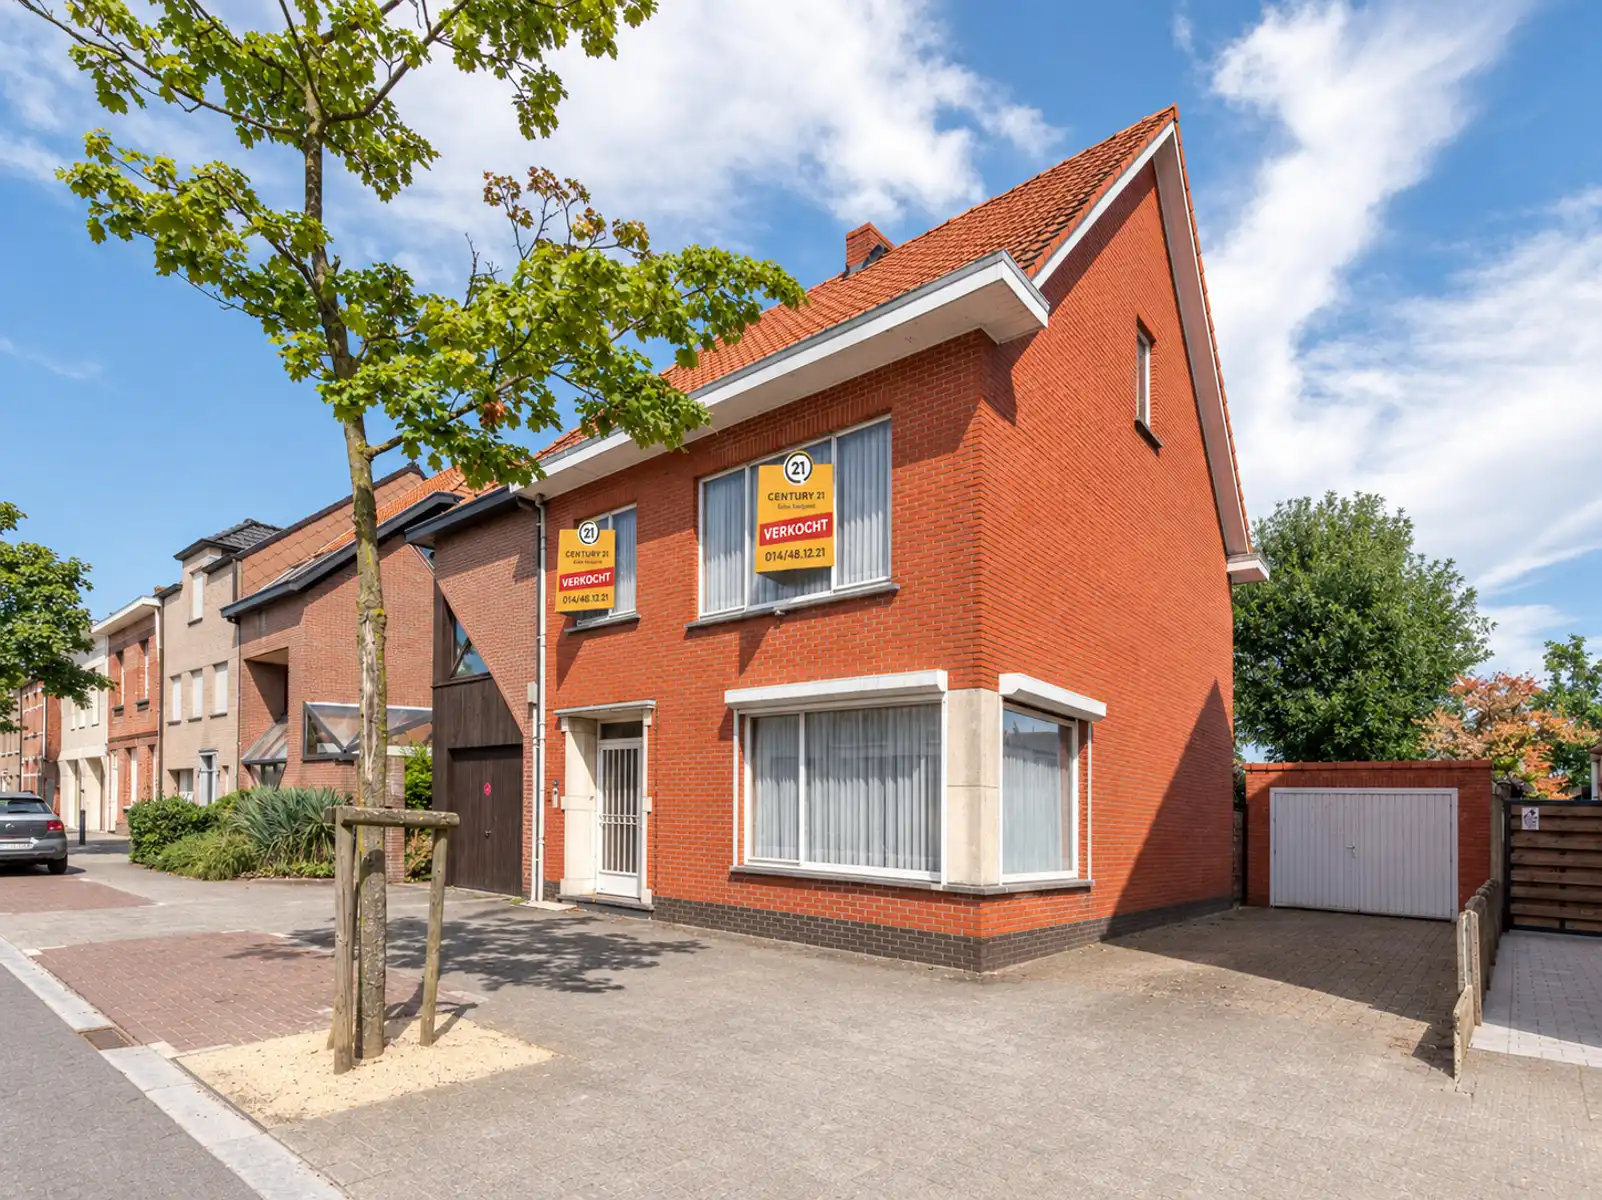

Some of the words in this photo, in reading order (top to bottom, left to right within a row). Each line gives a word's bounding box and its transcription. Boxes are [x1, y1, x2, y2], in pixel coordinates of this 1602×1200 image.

[791, 461, 805, 475] 21
[767, 491, 814, 501] CENTURY
[816, 491, 825, 500] 21
[583, 527, 594, 539] 21
[764, 519, 828, 540] VERKOCHT
[565, 550, 600, 558] CENTURY
[602, 550, 609, 558] 21
[765, 547, 825, 562] 014/48.12.21
[562, 572, 611, 588] VERKOCHT
